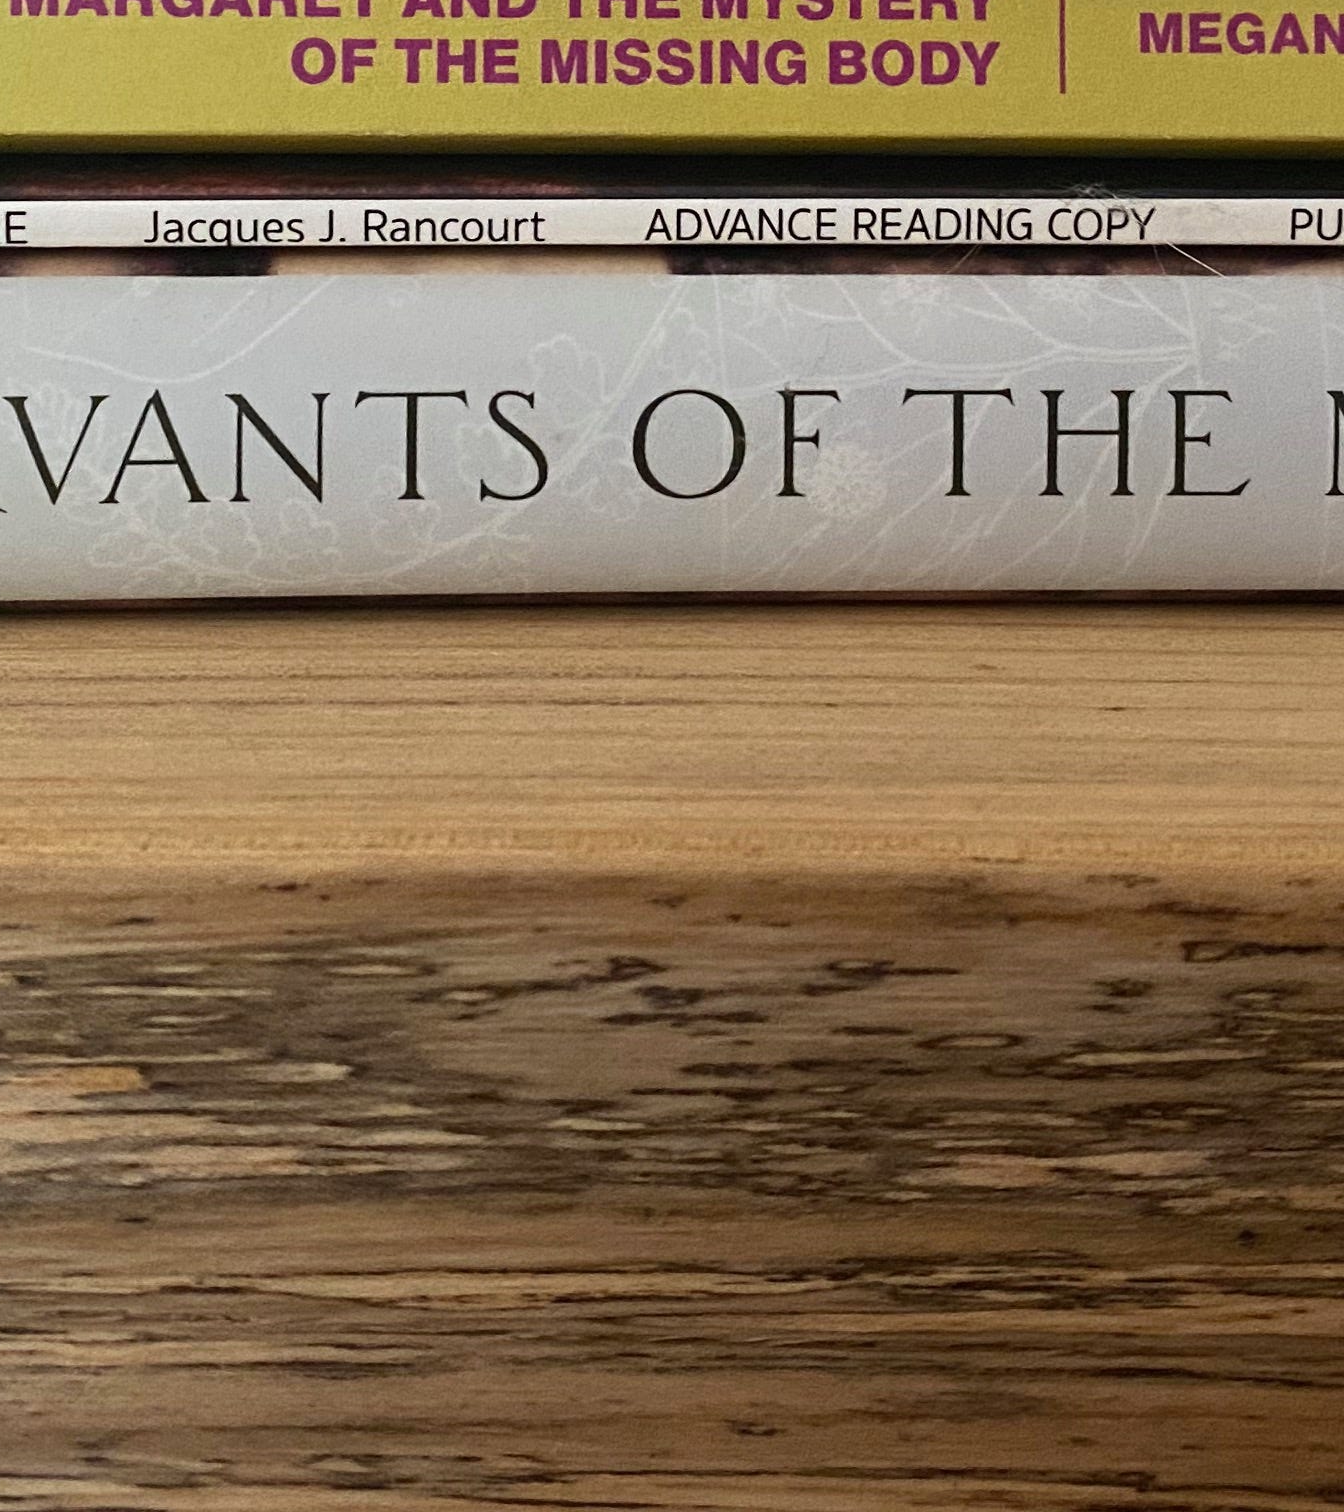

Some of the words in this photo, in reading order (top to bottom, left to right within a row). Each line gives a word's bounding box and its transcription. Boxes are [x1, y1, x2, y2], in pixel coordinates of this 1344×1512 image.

[290, 36, 378, 86] OF
[393, 38, 520, 85] THE
[540, 37, 807, 86] MISSING
[828, 39, 1001, 87] BODY
[143, 209, 305, 246] Jacques
[318, 209, 346, 243] J.
[363, 209, 546, 243] Rancourt
[644, 207, 838, 241] ADVANCE
[853, 207, 1034, 241] READING
[1047, 207, 1156, 241] COPY
[632, 387, 842, 500] OF
[902, 387, 1252, 497] THE
